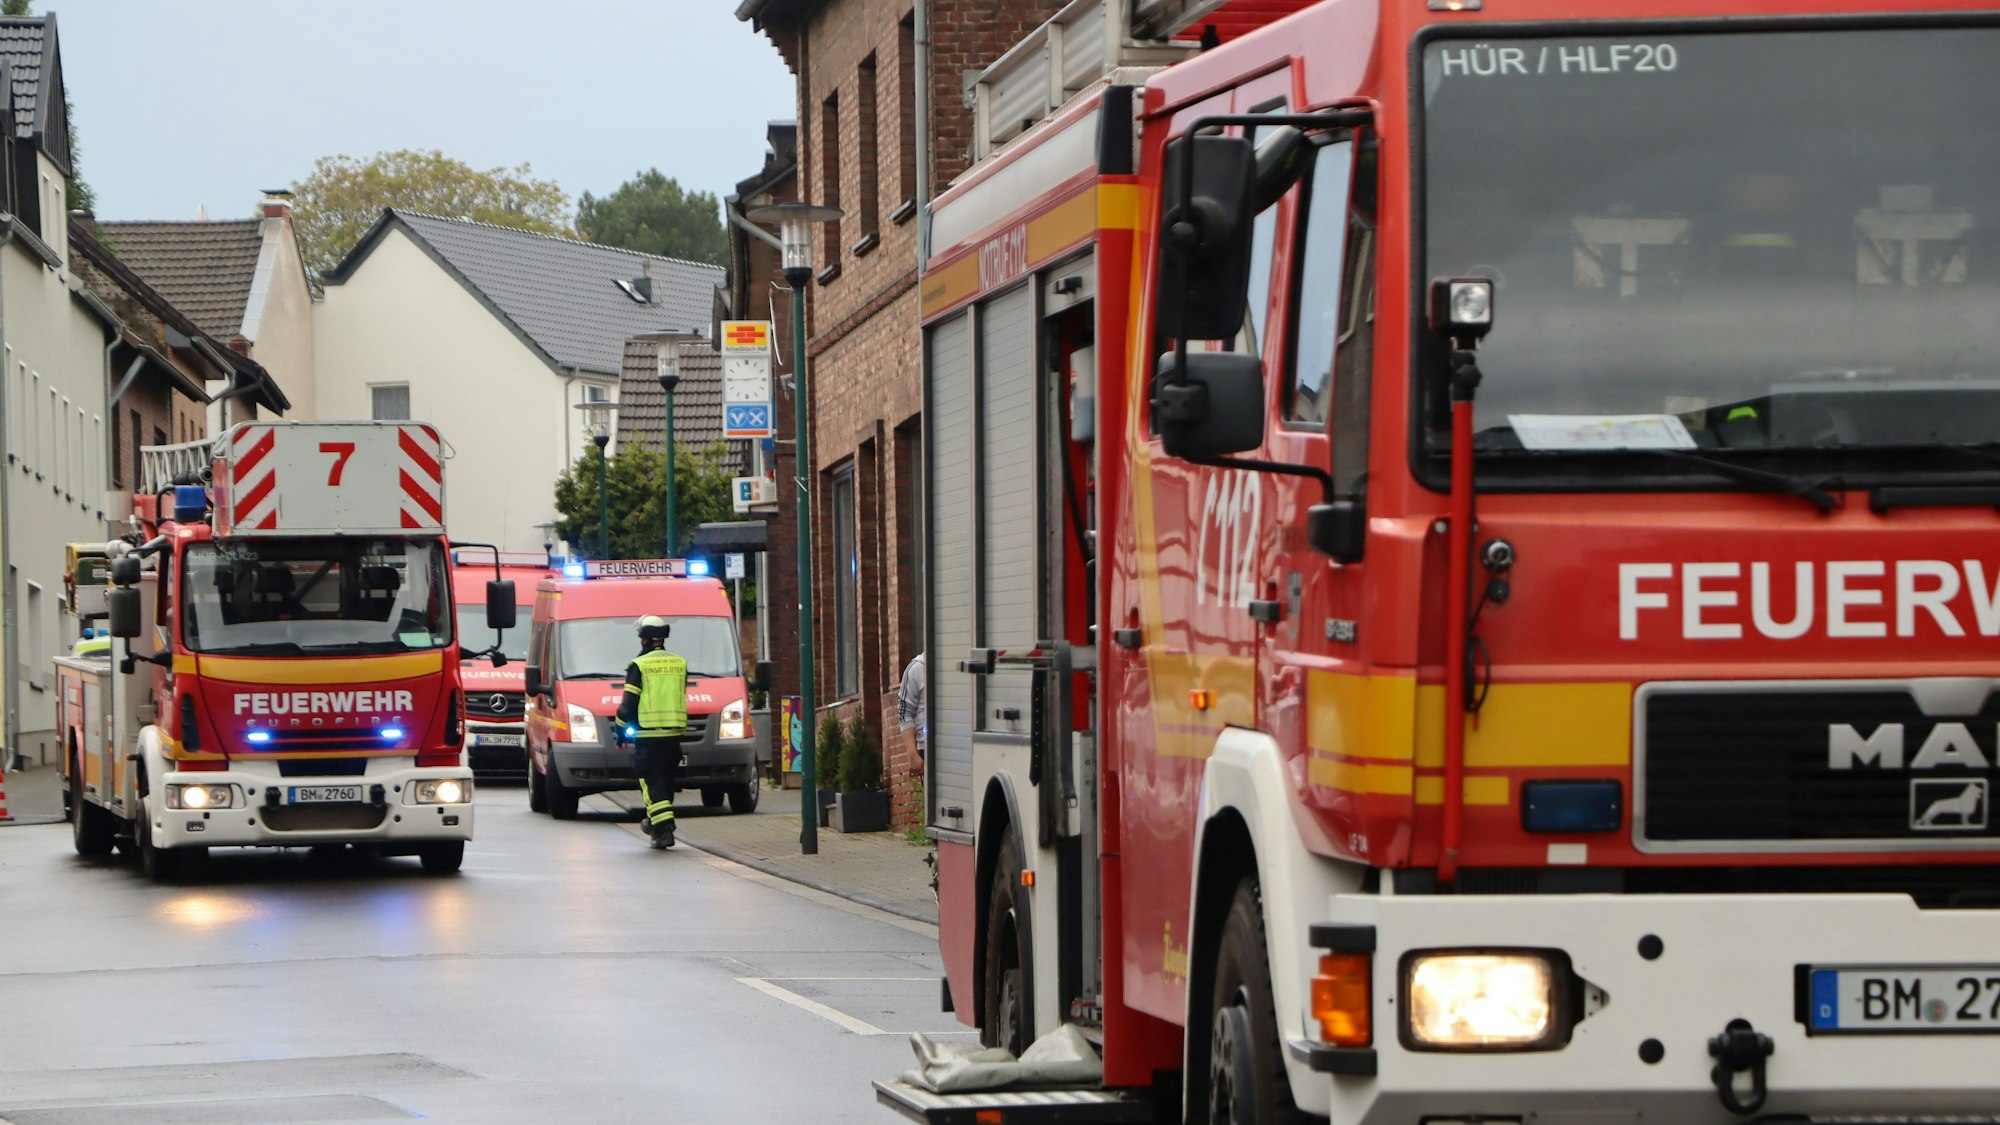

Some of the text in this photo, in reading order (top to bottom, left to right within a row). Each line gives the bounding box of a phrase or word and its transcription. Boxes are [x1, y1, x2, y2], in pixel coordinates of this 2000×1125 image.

[1441, 43, 1678, 76] HÜR / HLF20
[979, 232, 1009, 293] NOTRUF
[319, 442, 355, 486] 7
[1214, 469, 1263, 608] 112
[600, 561, 673, 574] FEUERWEHR
[459, 671, 525, 679] EUERWE
[233, 690, 413, 716] FEUERWEHR
[246, 716, 401, 728] EUROFIRE
[1828, 722, 2000, 770] MA
[301, 787, 355, 801] BM 2760
[1863, 978, 1921, 1020] BM
